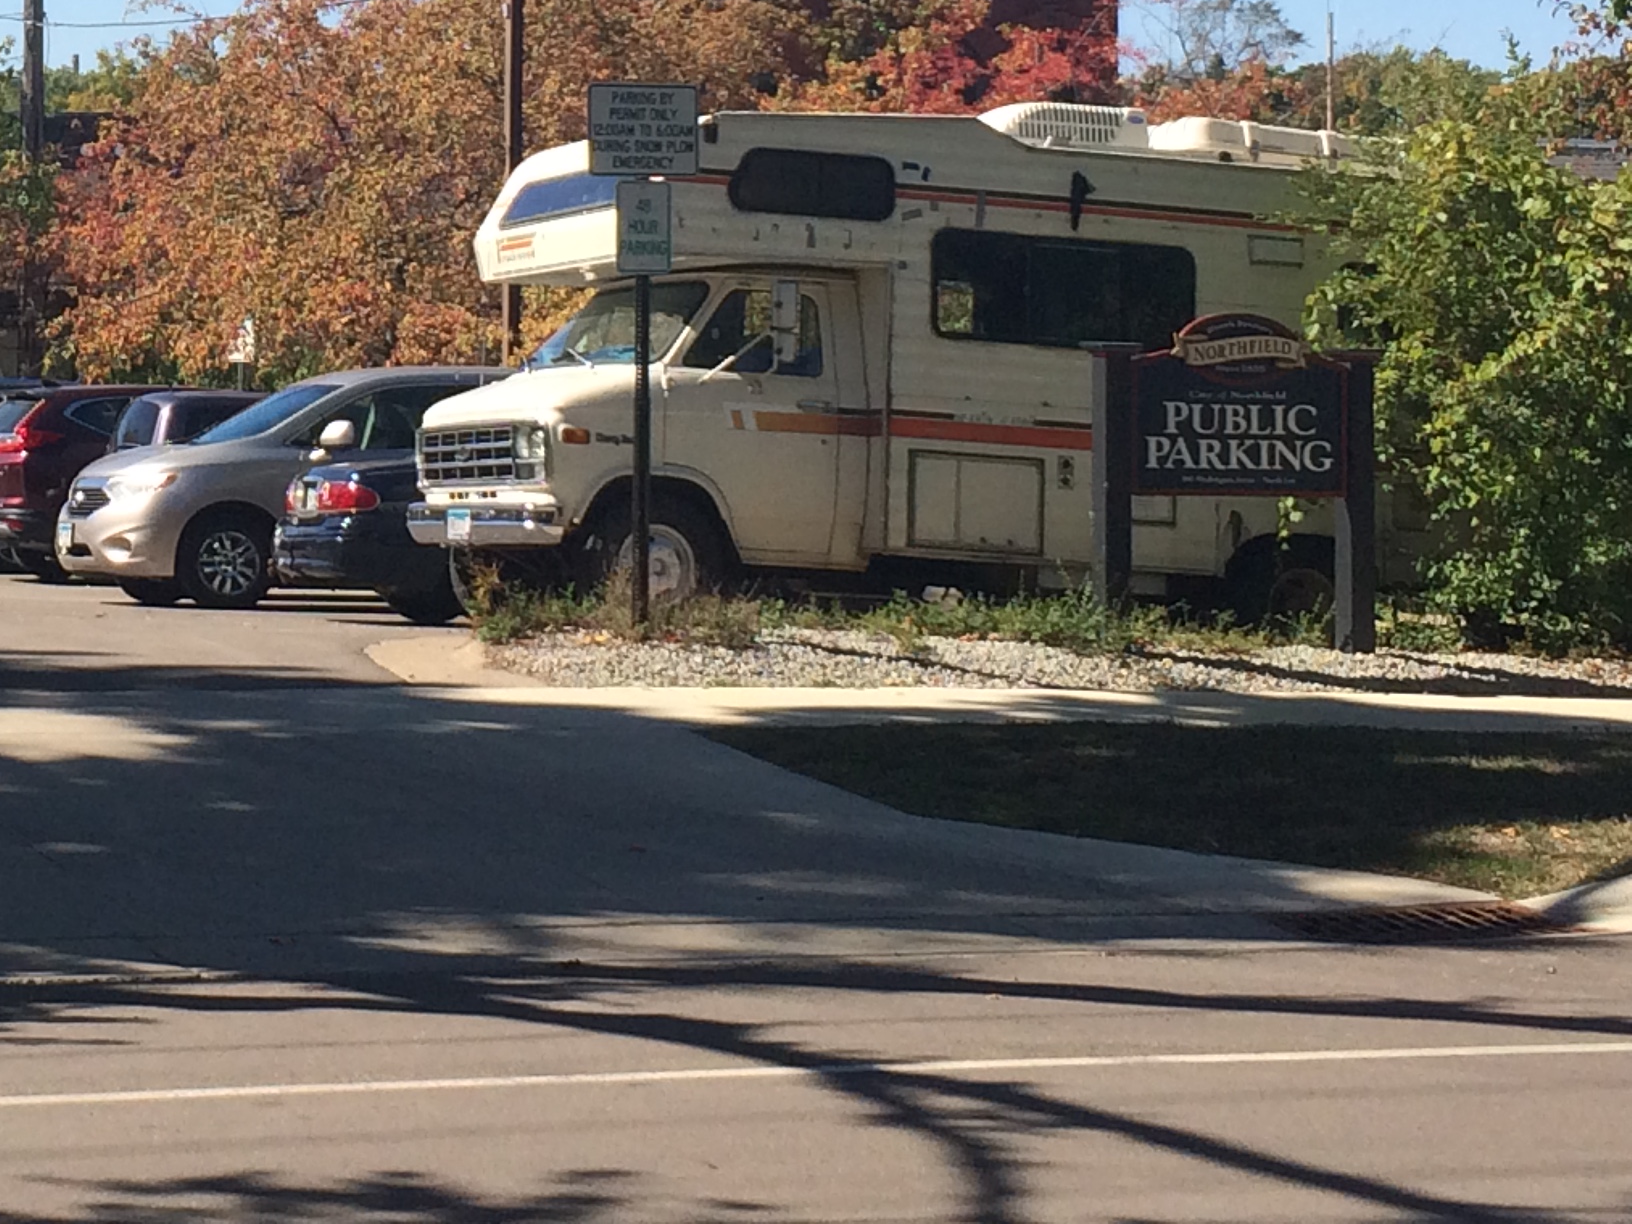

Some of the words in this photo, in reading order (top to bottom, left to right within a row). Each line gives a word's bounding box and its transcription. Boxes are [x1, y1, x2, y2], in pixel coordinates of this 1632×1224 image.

[611, 91, 657, 105] PARKING
[660, 92, 675, 105] BY
[609, 107, 646, 120] PERMIT
[650, 108, 679, 121] ONLY
[639, 124, 652, 136] TO
[593, 139, 631, 153] DURING
[634, 140, 662, 153] SNOW
[666, 141, 694, 153] PLOW
[612, 156, 675, 169] EMERGENCY
[628, 219, 658, 234] HOUR
[620, 239, 669, 256] PARKING
[1193, 339, 1292, 361] NORTHFIELD
[1162, 401, 1317, 435] PUBLIC
[1145, 436, 1334, 472] PARKING
